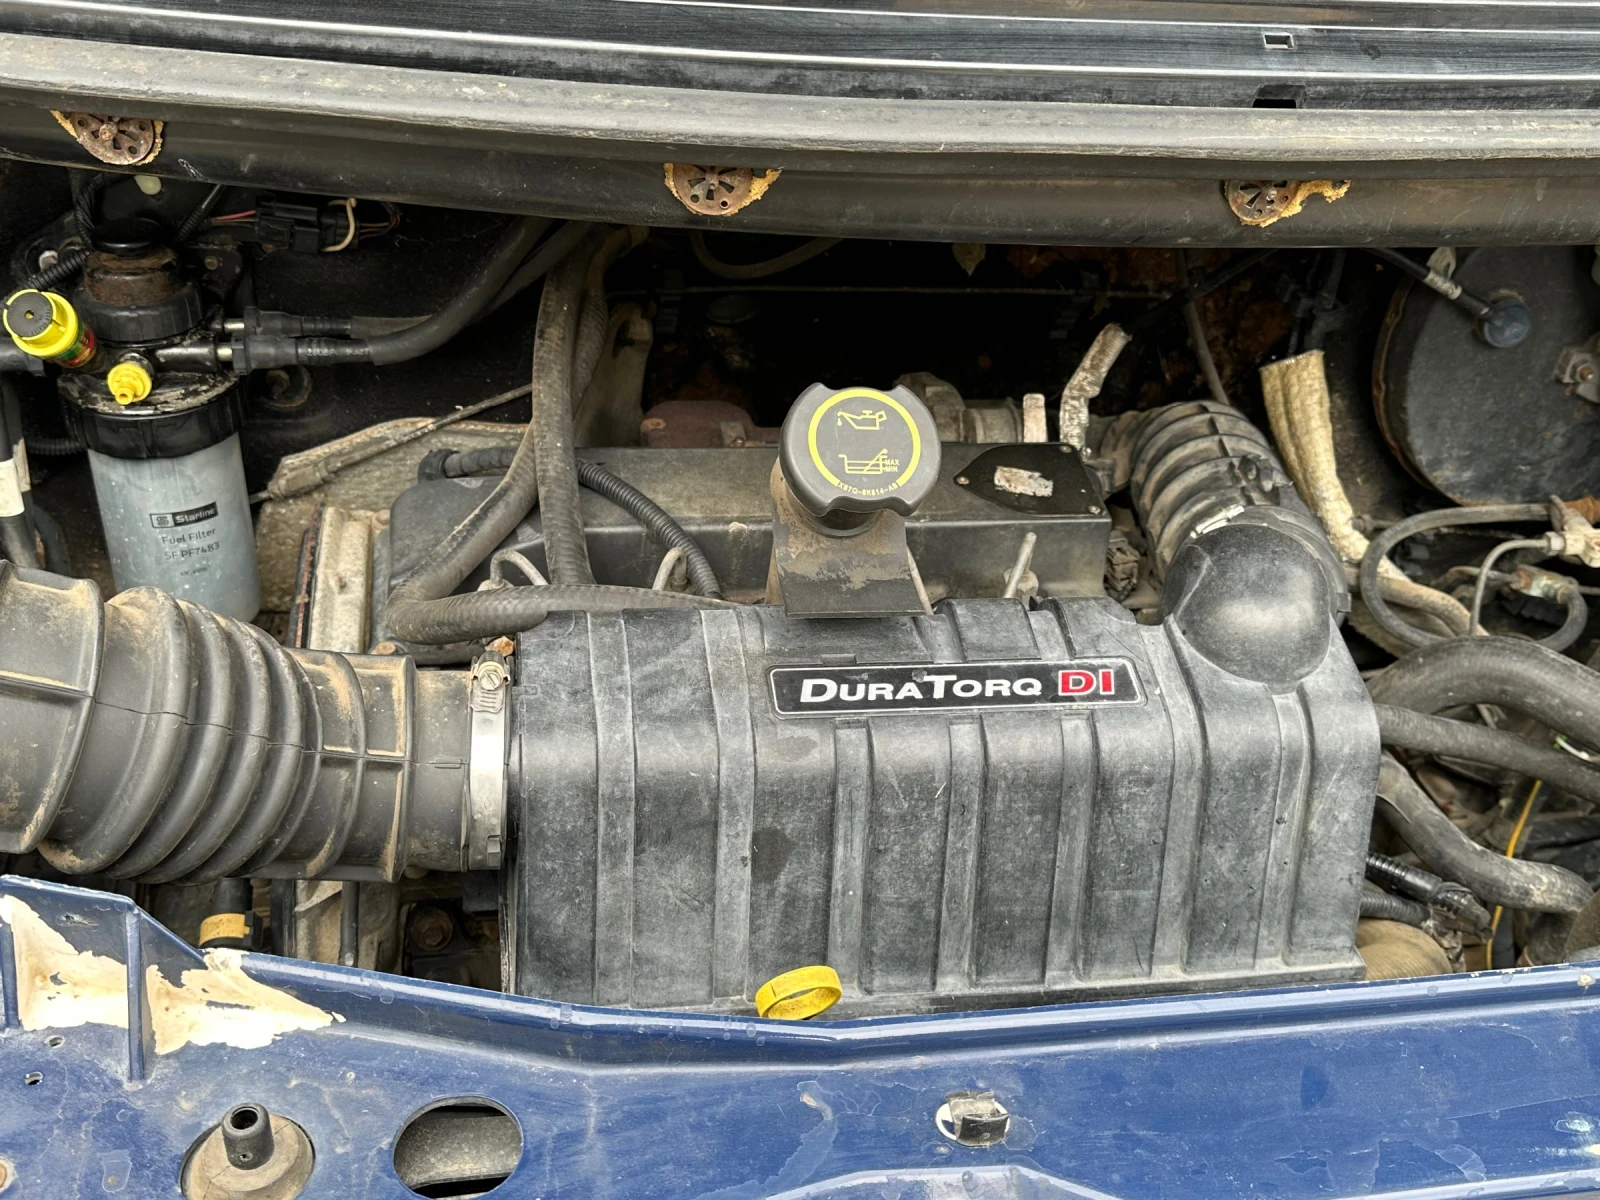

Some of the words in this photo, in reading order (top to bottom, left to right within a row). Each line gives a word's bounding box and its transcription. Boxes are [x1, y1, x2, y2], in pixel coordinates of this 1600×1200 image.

[175, 507, 215, 524] Starline
[161, 534, 186, 545] Fuel
[188, 528, 217, 541] Filter
[164, 550, 178, 560] SF
[180, 541, 220, 558] PF7483
[1057, 668, 1115, 697] DI
